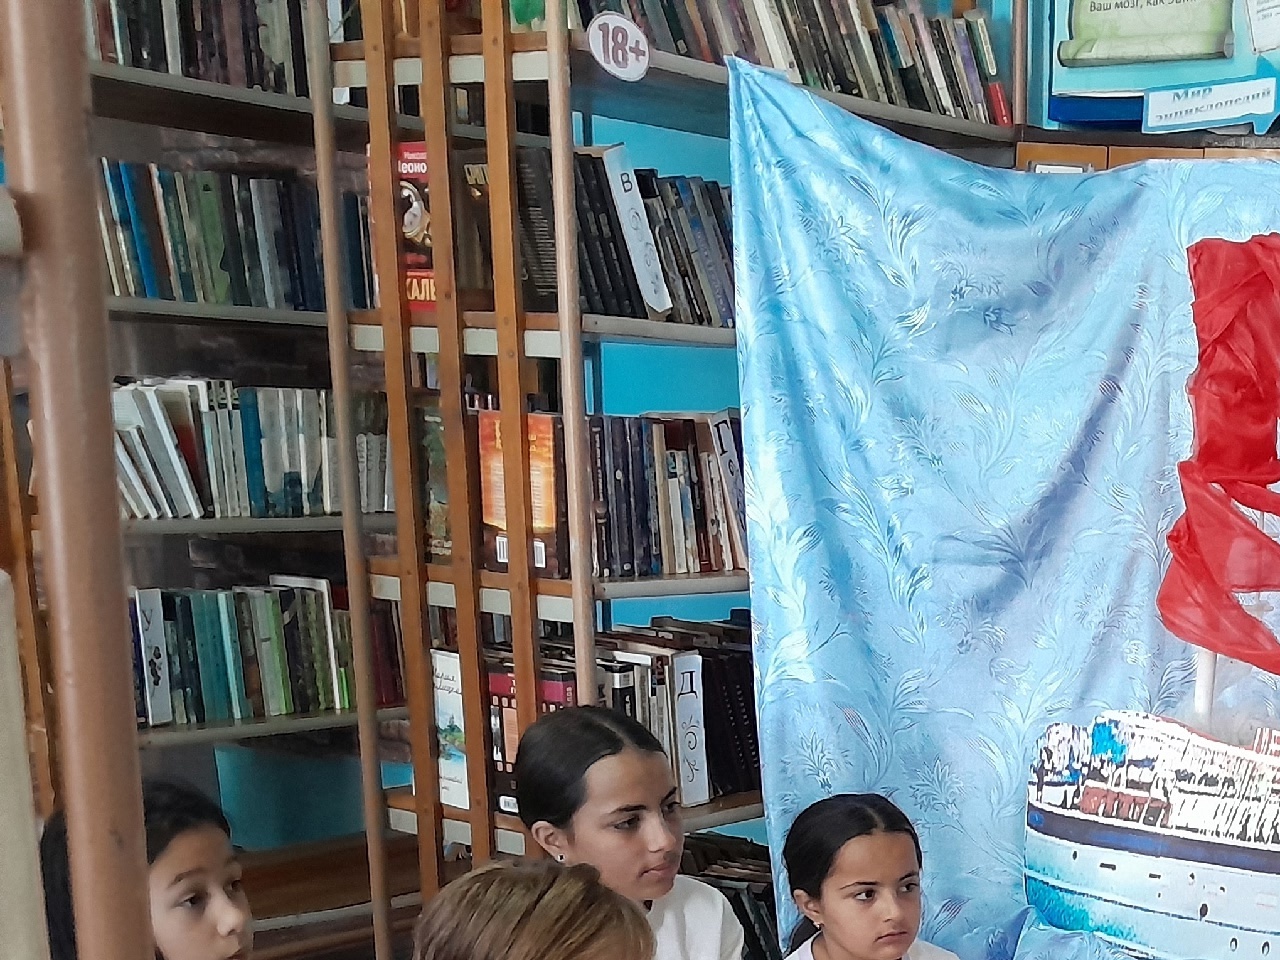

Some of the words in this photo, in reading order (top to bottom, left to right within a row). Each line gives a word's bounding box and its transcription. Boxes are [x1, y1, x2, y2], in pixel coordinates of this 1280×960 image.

[1089, 1, 1111, 12] Ваш
[598, 22, 646, 69] 18+
[1172, 86, 1213, 102] Мир
[398, 160, 428, 174] еоно
[677, 670, 698, 701] Д
